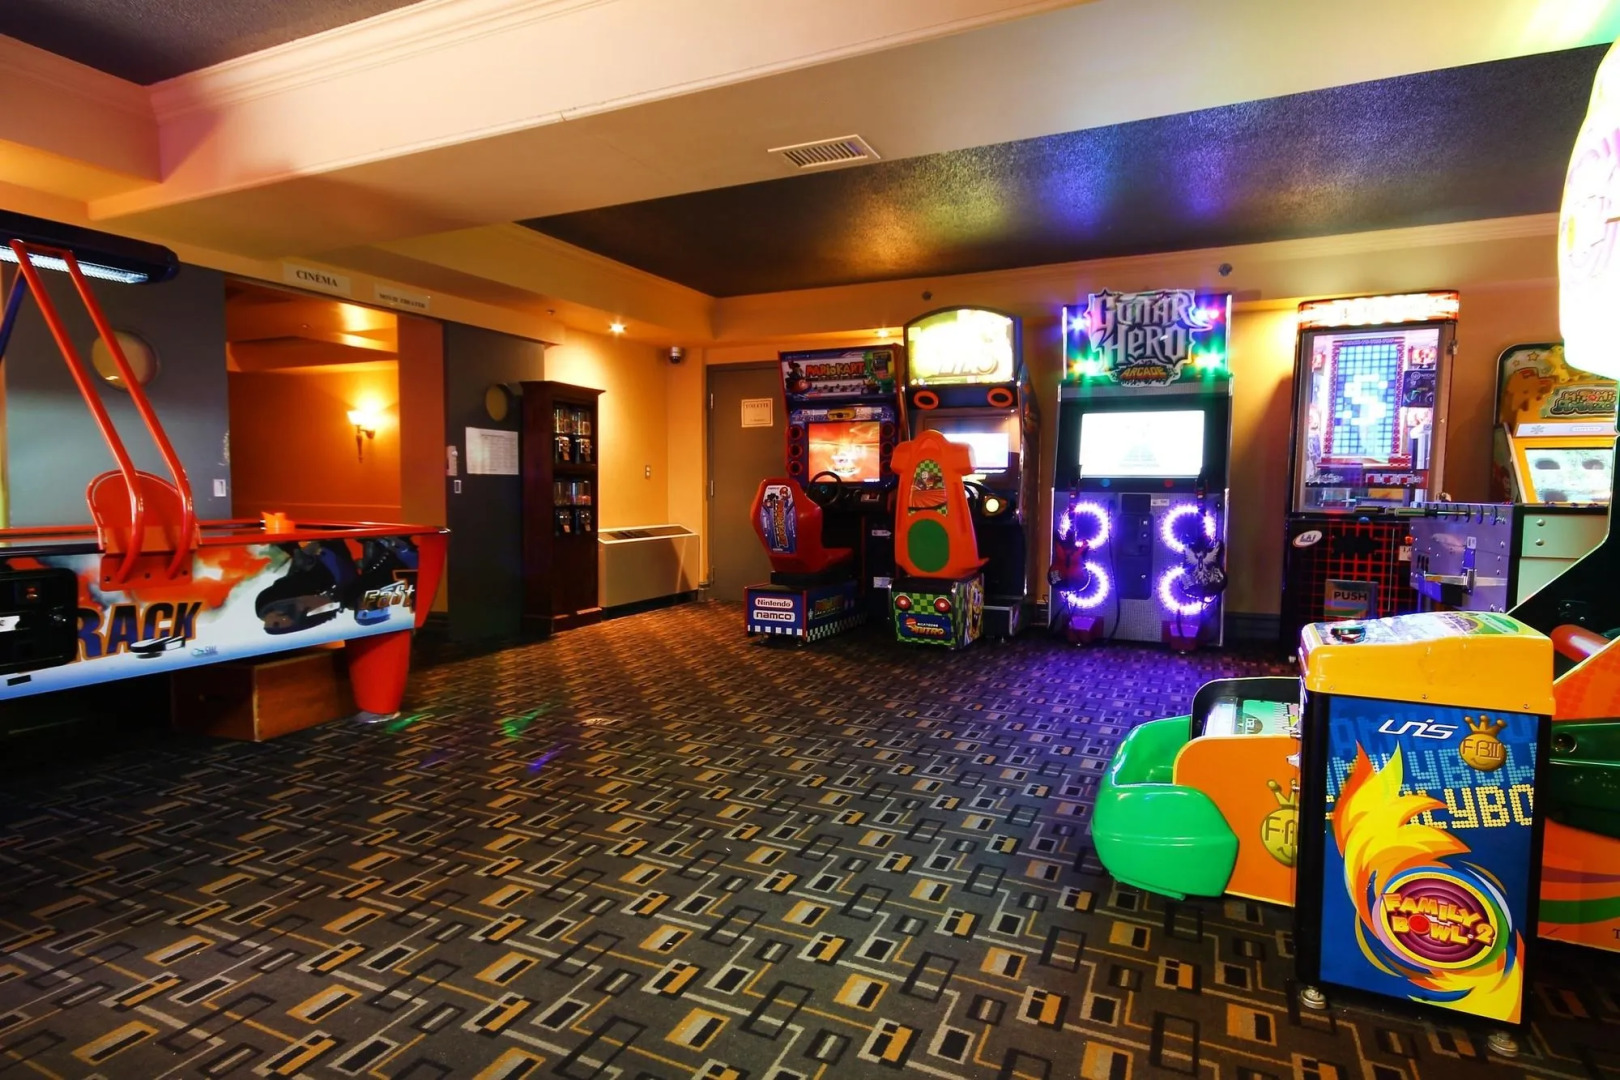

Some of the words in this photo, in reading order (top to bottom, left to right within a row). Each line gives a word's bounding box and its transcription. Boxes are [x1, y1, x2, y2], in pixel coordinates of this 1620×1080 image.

[1088, 290, 1200, 349] GUITAR
[1100, 323, 1187, 368] HERO
[1120, 366, 1167, 380] ARCADE
[757, 599, 791, 607] Nintendo
[1333, 591, 1367, 601] PUSH
[756, 611, 792, 620] namco
[1382, 893, 1482, 928] FAMILY
[1391, 913, 1470, 945] BOWL
